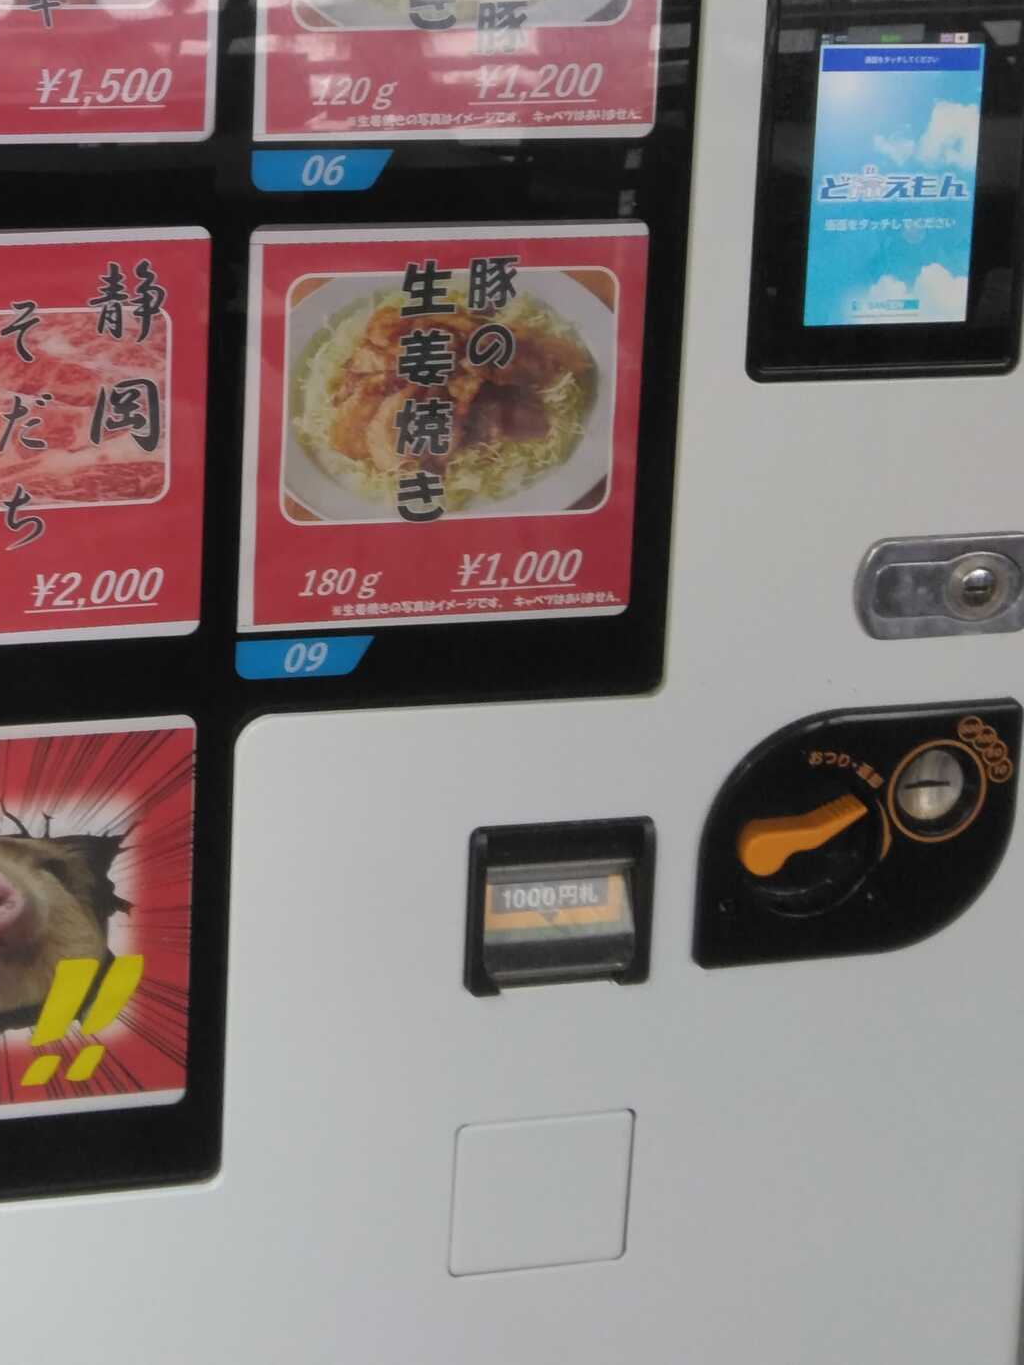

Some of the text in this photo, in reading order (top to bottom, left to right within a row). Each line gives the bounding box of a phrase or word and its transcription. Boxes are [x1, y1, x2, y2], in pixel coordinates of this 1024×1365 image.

[34, 67, 172, 108] ¥1,500
[475, 63, 603, 103] ¥1,200
[302, 155, 346, 186] 06
[465, 255, 519, 369] 豚の
[89, 260, 166, 452] 静岡
[395, 259, 456, 523] 生姜焼き
[29, 567, 164, 610] ¥2,000
[456, 548, 583, 589] ¥1,000
[283, 642, 329, 673] 09
[500, 880, 598, 911] 1000円札
